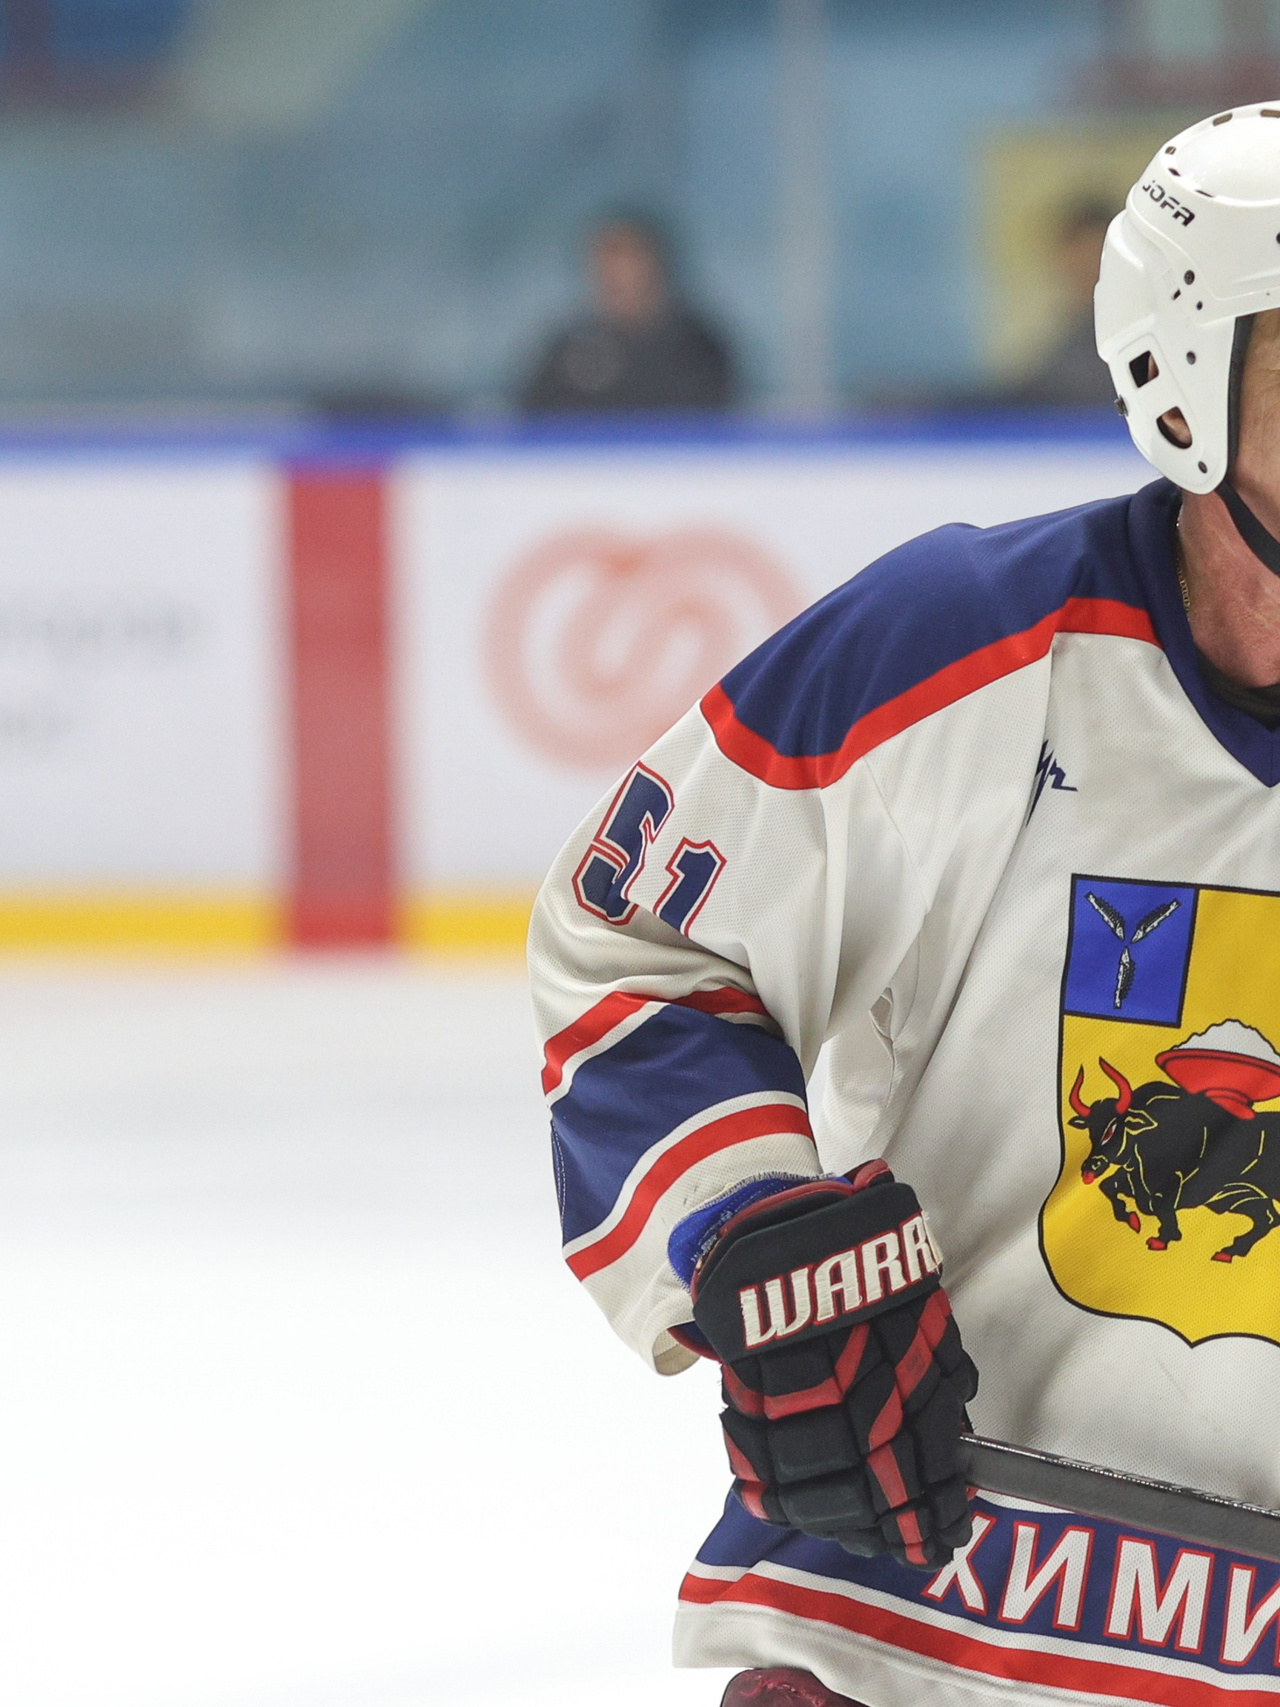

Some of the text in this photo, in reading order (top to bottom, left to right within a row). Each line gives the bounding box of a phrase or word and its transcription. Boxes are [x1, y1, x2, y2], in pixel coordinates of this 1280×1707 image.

[1142, 180, 1195, 227] JOFA
[571, 761, 727, 937] 51
[738, 1210, 944, 1349] WARR
